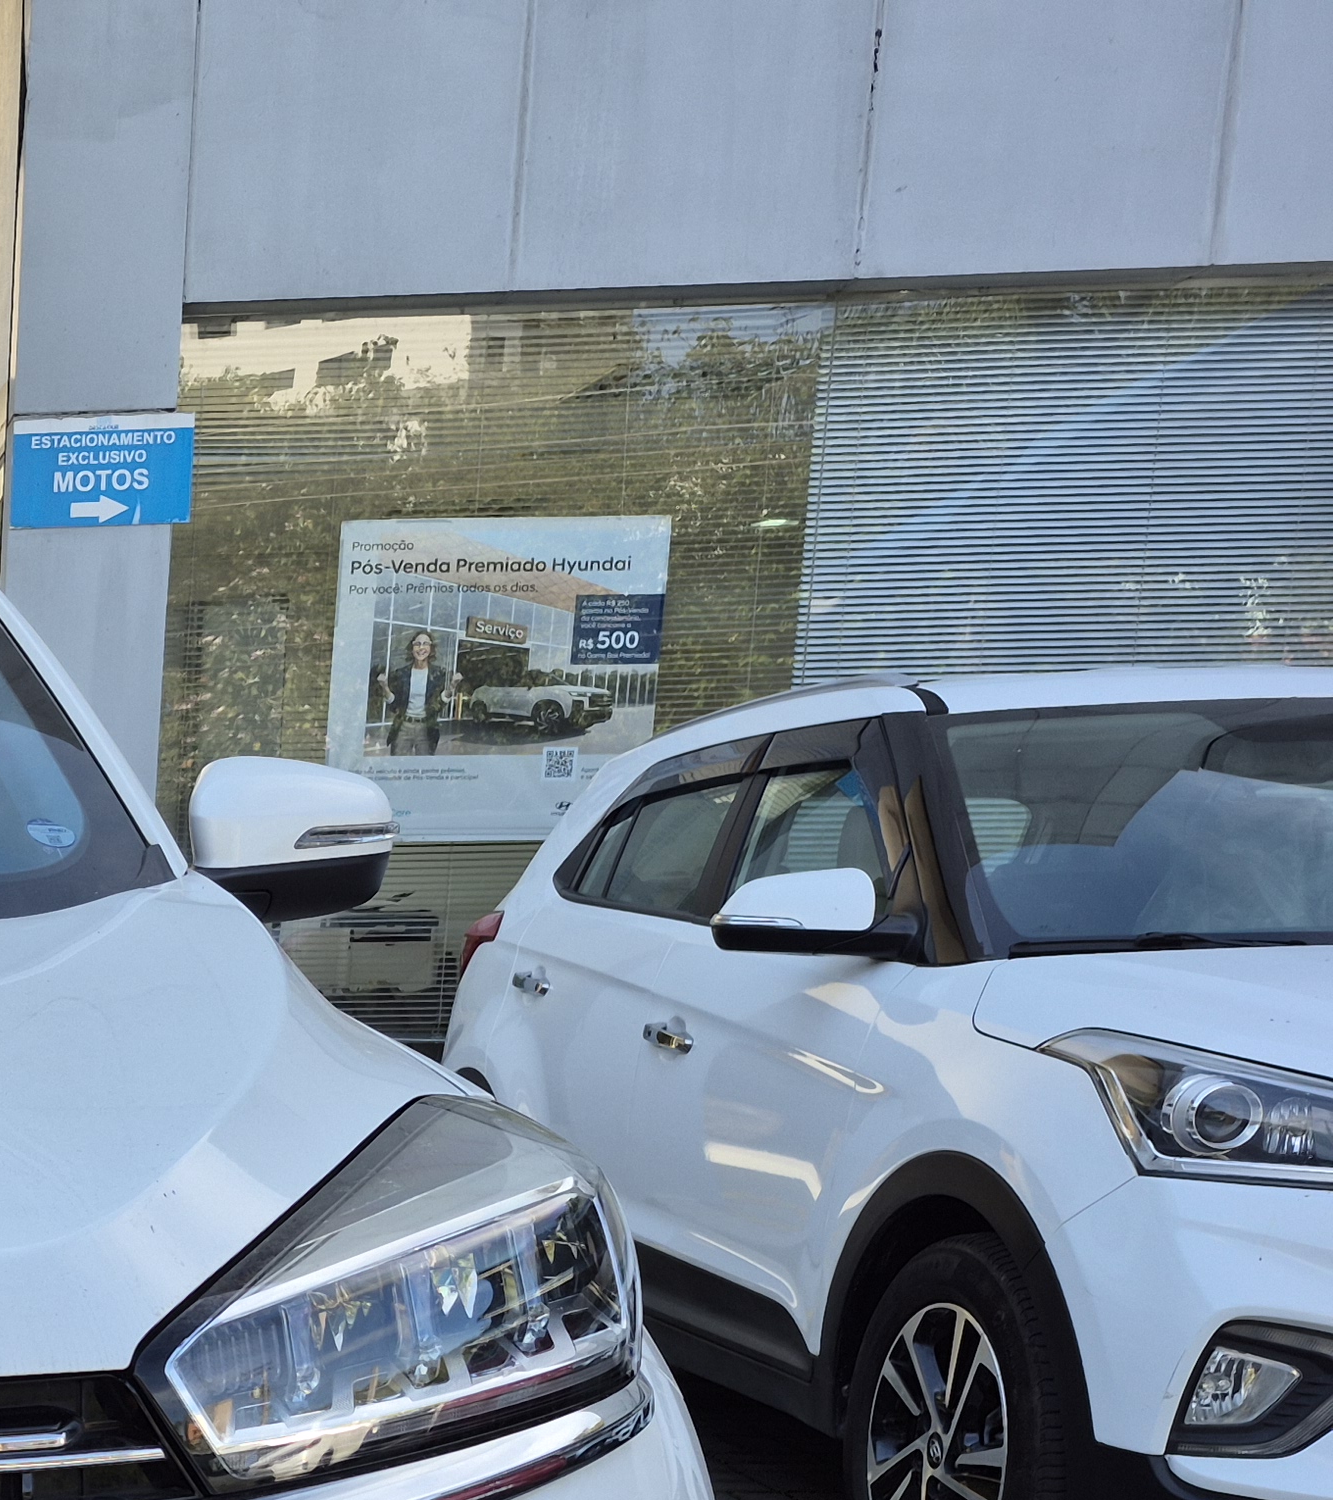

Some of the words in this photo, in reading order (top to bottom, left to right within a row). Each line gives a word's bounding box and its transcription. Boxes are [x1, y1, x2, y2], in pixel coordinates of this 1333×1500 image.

[31, 431, 176, 449] ESTACIONAMENTO
[58, 450, 148, 466] EXCLUSIVO
[53, 468, 150, 493] MOTOS
[352, 540, 414, 552] Promoção
[350, 558, 450, 575] Pós-Venda
[456, 557, 546, 573] Premiado
[552, 555, 632, 575] Hyundai
[349, 584, 369, 595] Por
[371, 583, 403, 595] você:
[405, 583, 454, 594] Prêmios
[493, 584, 508, 594] os
[510, 582, 539, 593] dias.
[475, 621, 524, 639] Serviço
[578, 638, 594, 650] R$
[596, 630, 640, 650] 500
